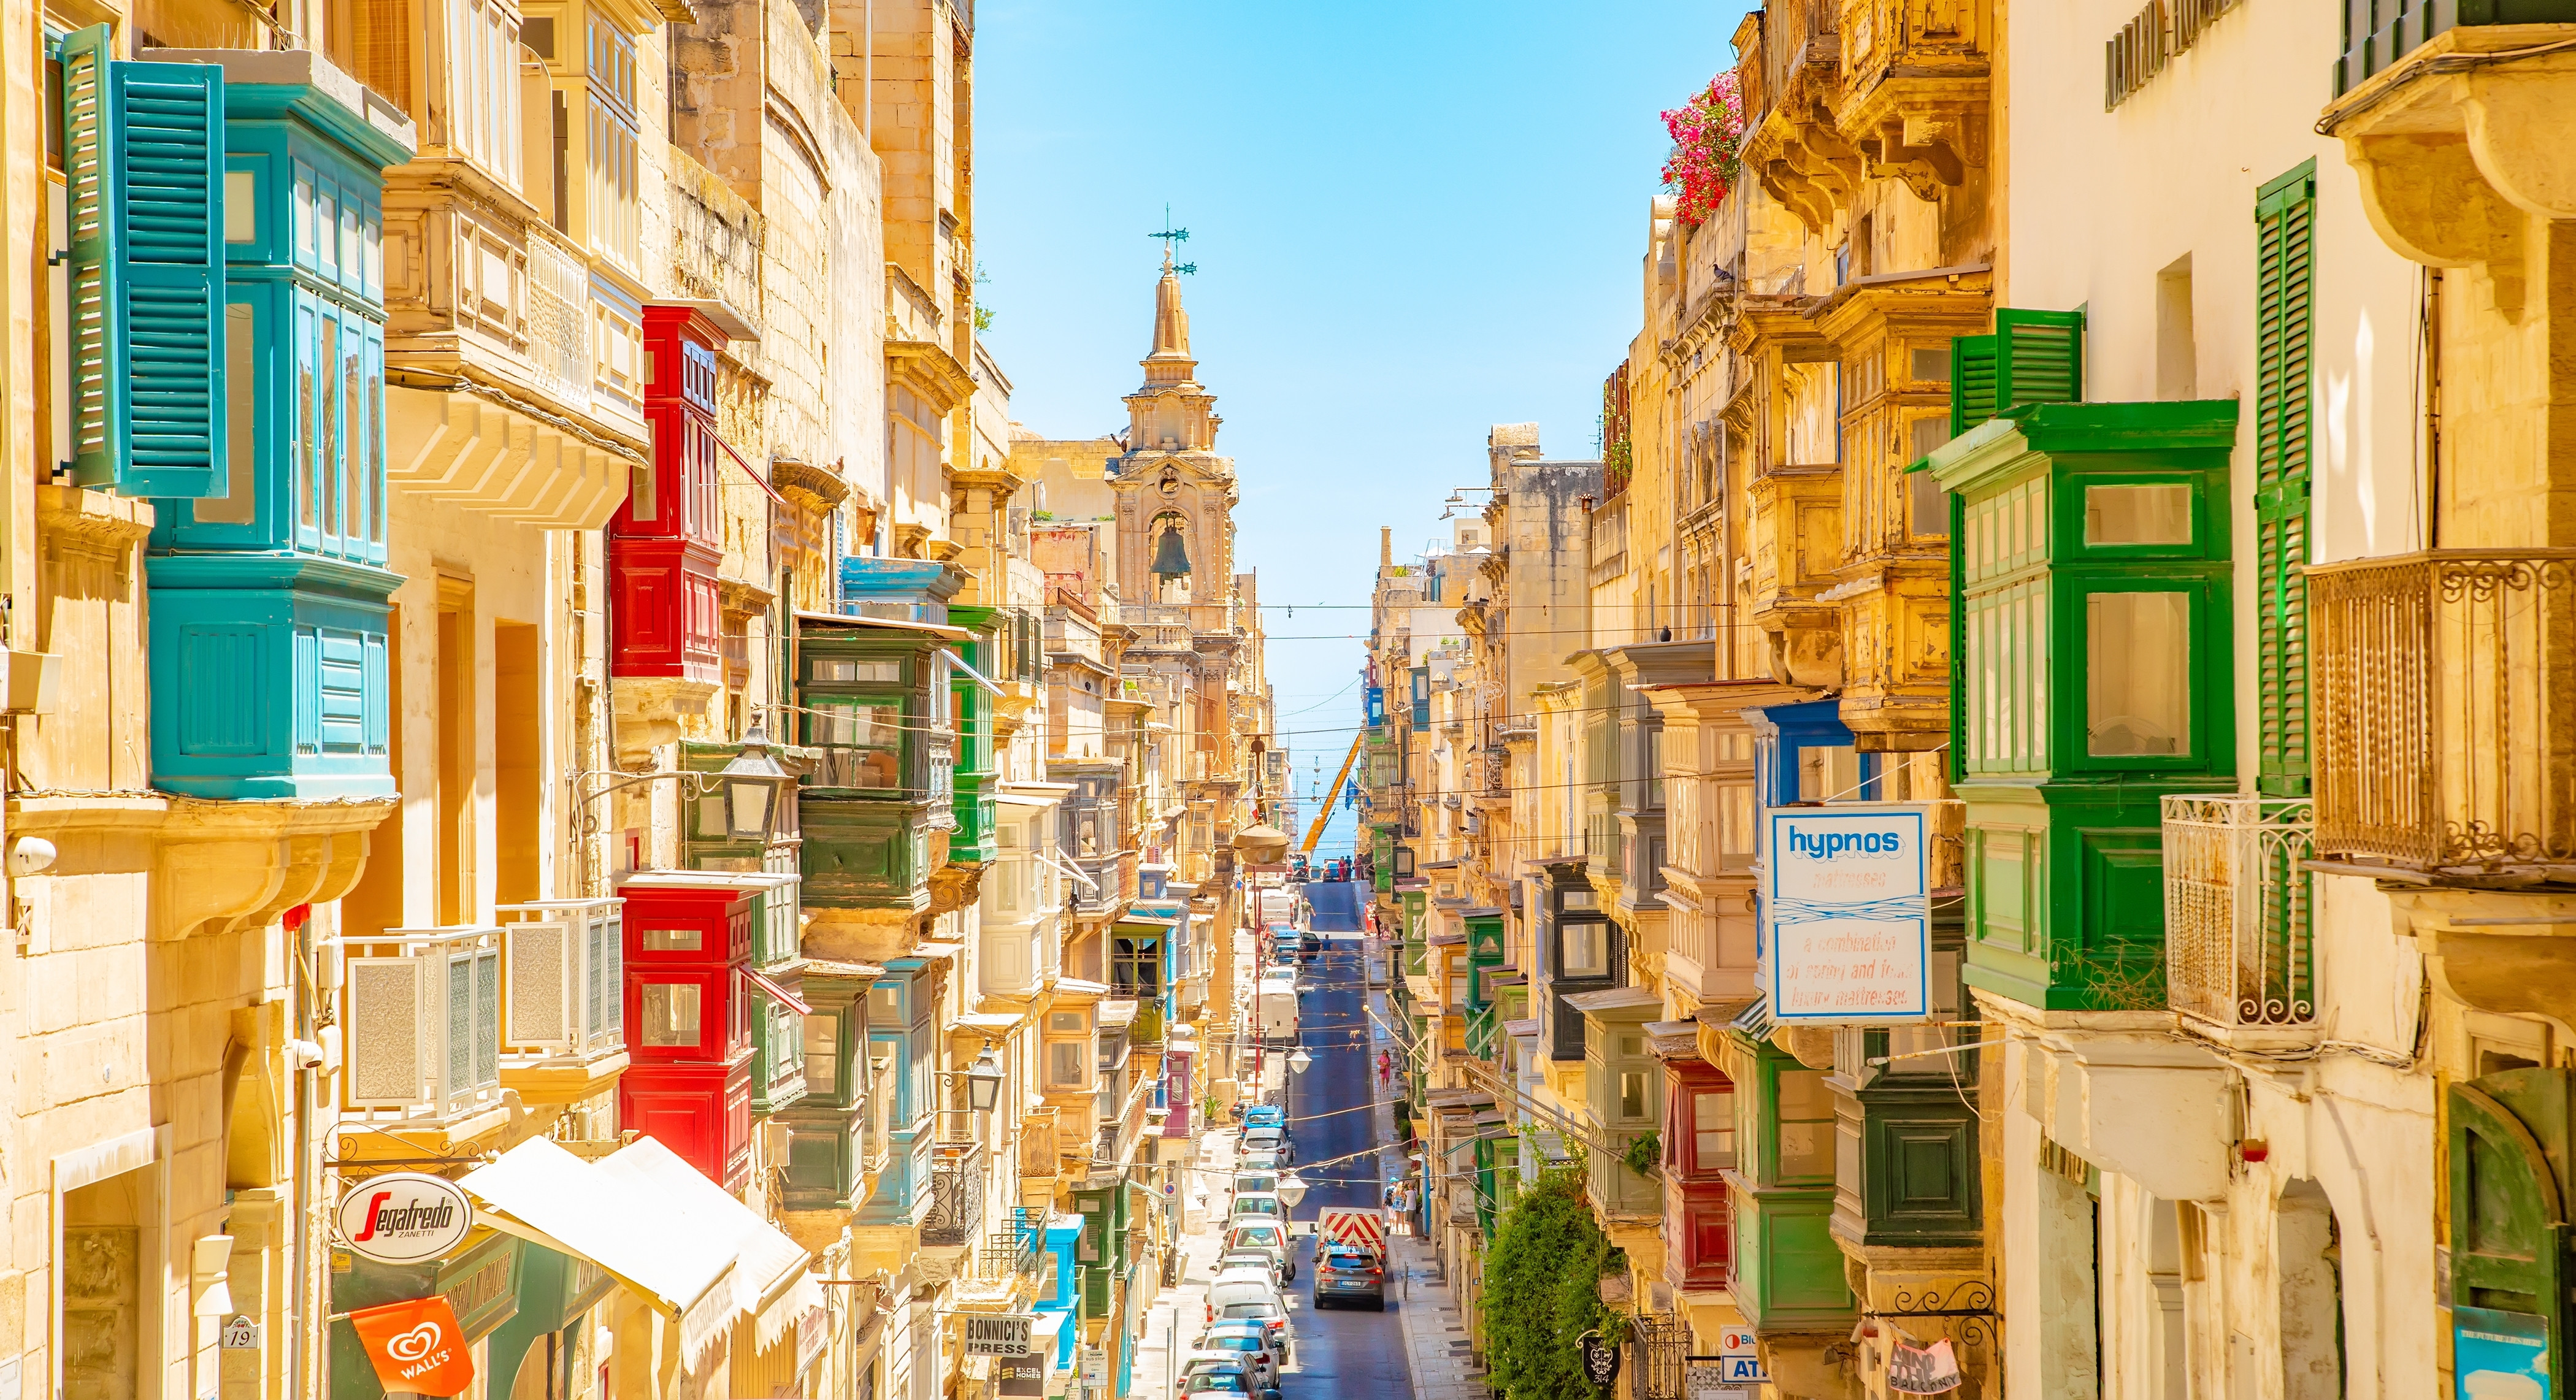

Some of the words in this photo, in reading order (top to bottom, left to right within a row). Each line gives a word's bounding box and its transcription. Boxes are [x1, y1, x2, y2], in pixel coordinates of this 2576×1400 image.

[1789, 825, 1900, 860] hypnos
[1851, 958, 1876, 979] and
[355, 1192, 453, 1242] Segafredo
[398, 1230, 434, 1238] ZANETTI
[472, 1250, 511, 1312] MICALLEF
[231, 1331, 250, 1346] 19
[967, 1319, 1029, 1342] BONNICI'S
[968, 1343, 1027, 1355] PRESS
[1891, 1343, 1936, 1372] MIND
[401, 1350, 450, 1380] WALL'S
[1733, 1361, 1767, 1377] AT
[1593, 1374, 1609, 1383] 314
[1891, 1374, 1957, 1392] BALCONY
